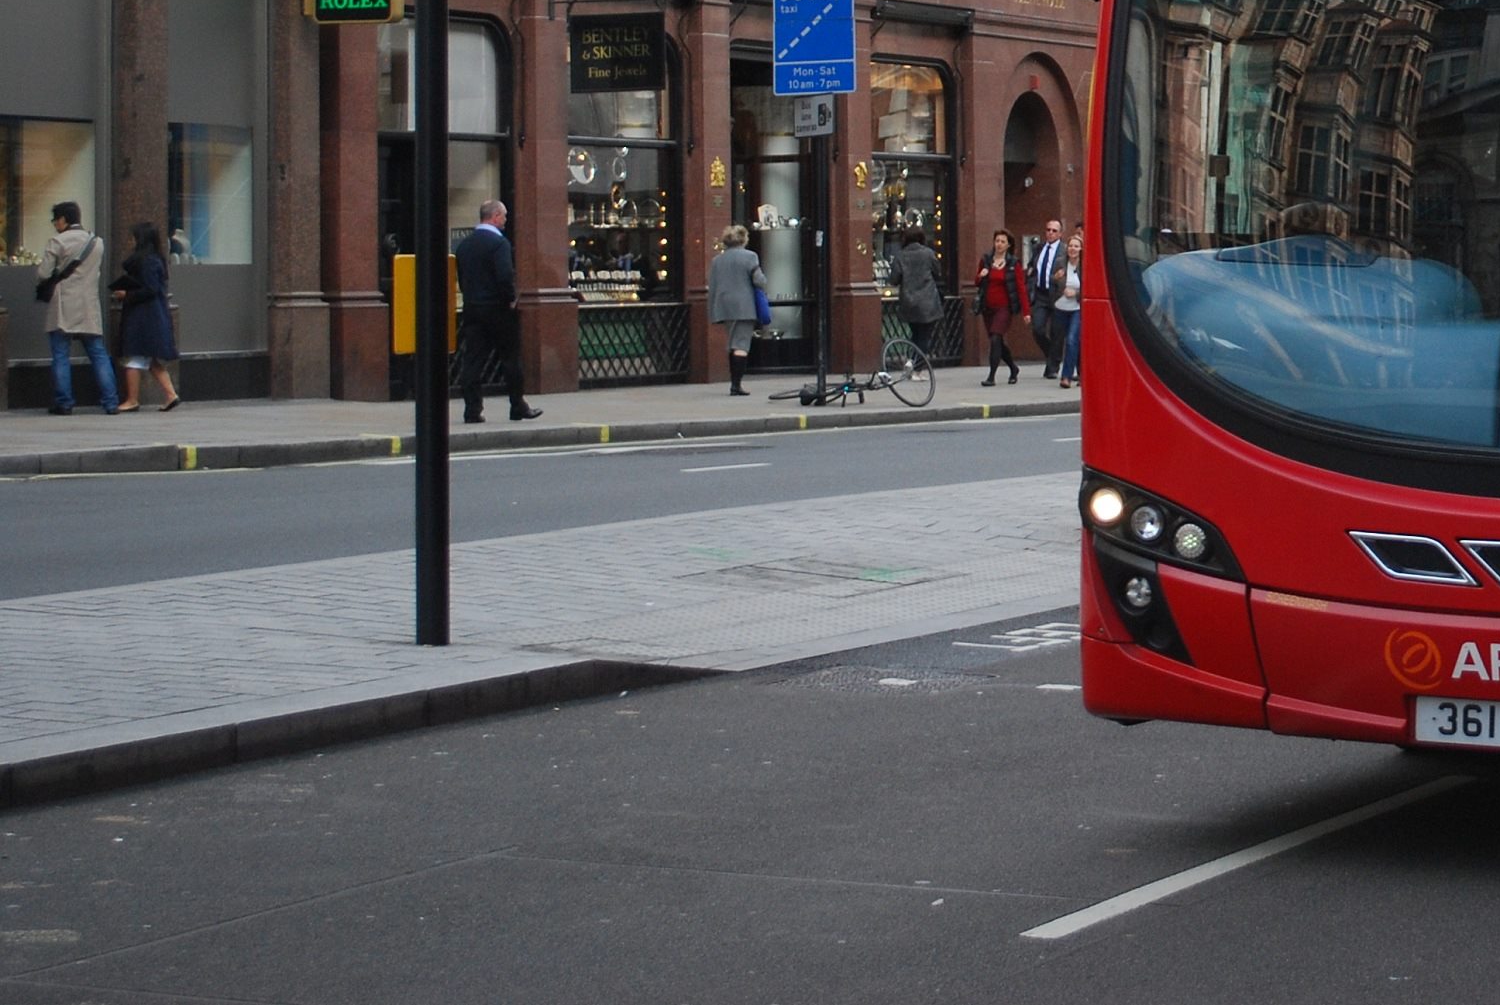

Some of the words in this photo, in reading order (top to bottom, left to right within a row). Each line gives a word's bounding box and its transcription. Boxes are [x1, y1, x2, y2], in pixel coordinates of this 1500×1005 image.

[780, 5, 798, 13] taxi
[582, 27, 650, 44] BENTLEY
[582, 49, 592, 60] &
[593, 43, 651, 59] SKINNER
[588, 67, 612, 78] Fine
[613, 66, 647, 80] Jewels
[1437, 702, 1496, 739] 361
